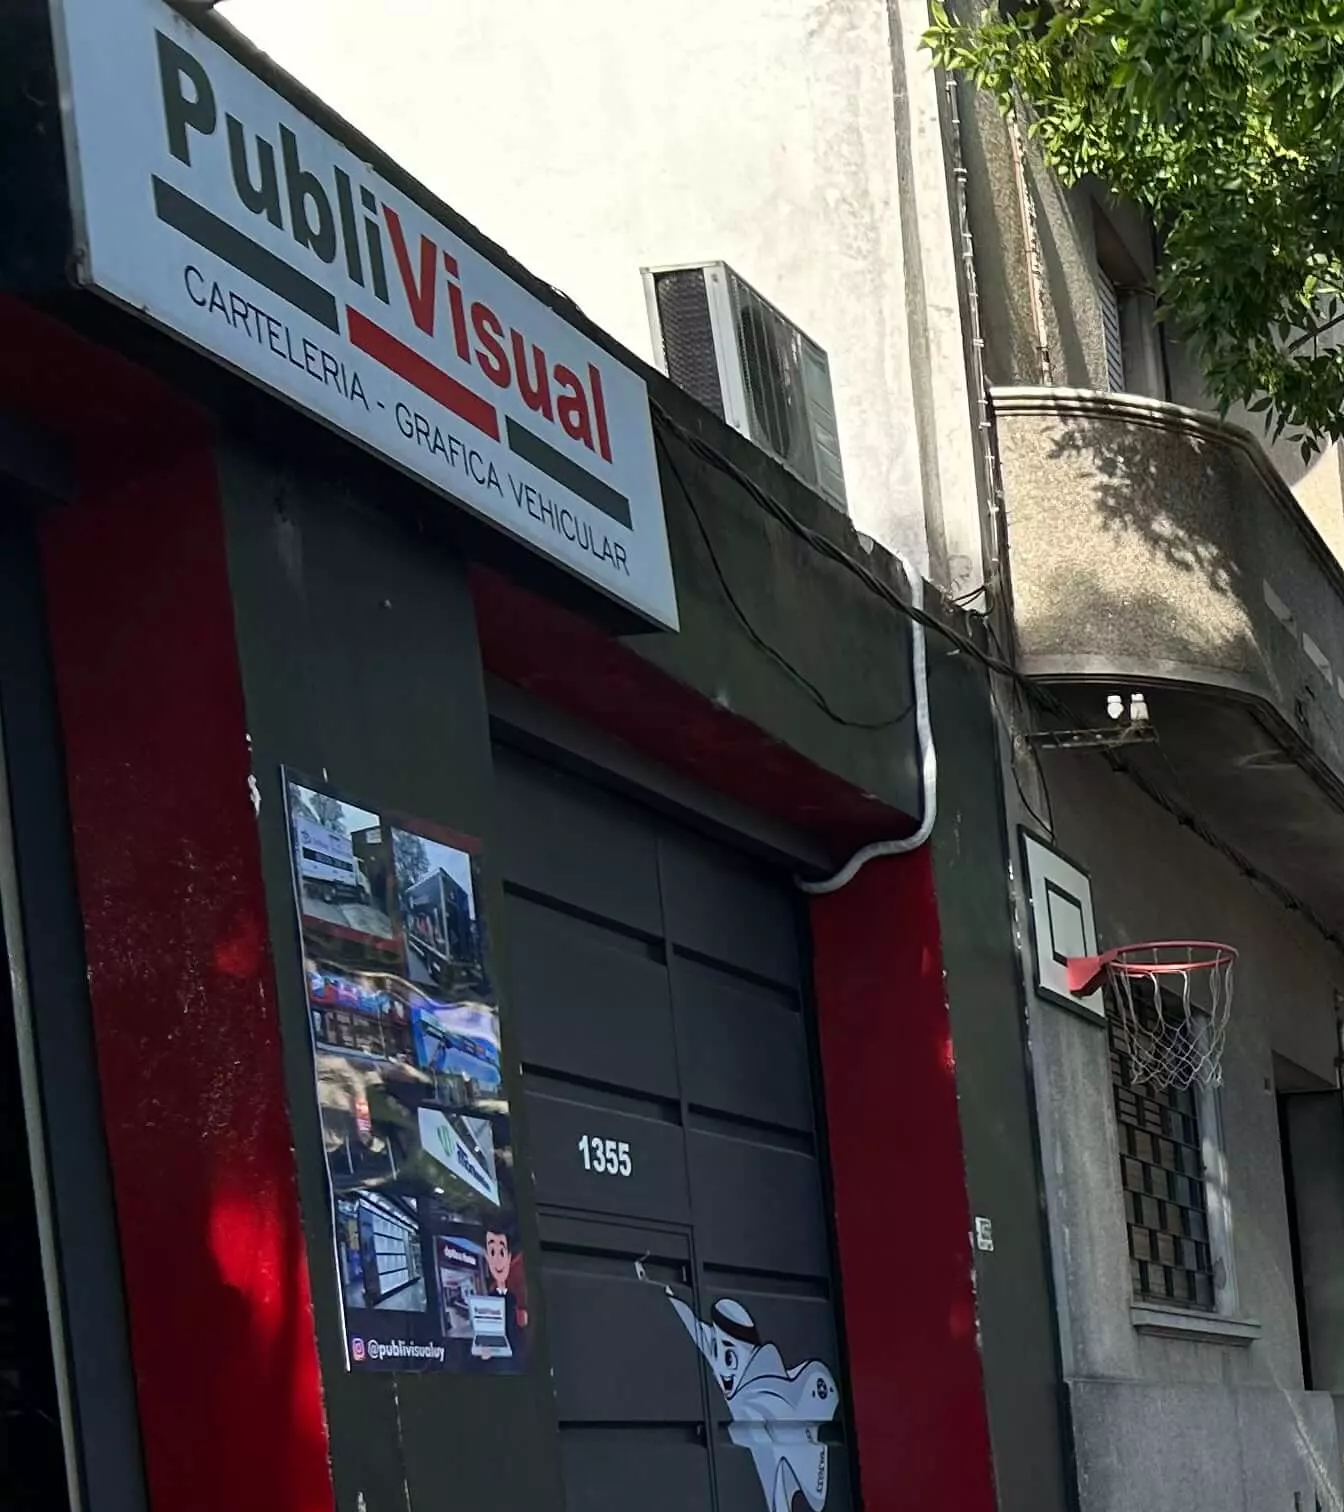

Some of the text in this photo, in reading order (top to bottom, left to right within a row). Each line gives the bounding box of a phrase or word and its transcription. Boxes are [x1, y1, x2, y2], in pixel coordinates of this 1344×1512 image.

[154, 28, 613, 464] PubliVisual
[183, 264, 371, 413] CARTELERIA
[395, 402, 503, 498] GRAFICA
[507, 473, 630, 577] VEHICULAR
[579, 1135, 632, 1177] 1355
